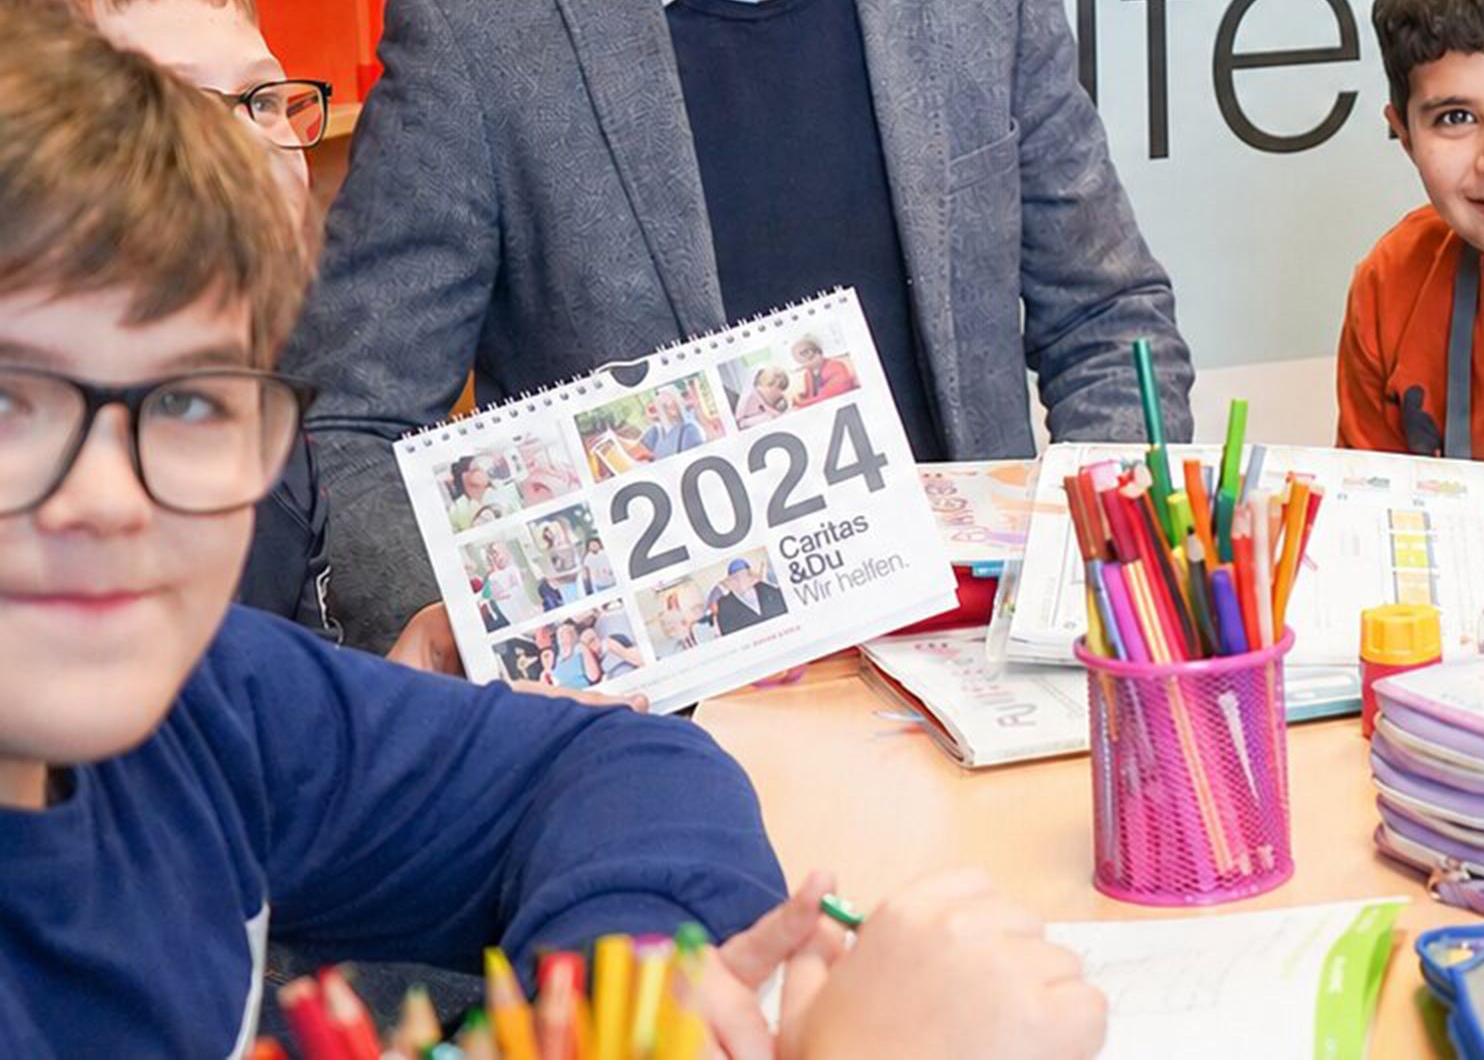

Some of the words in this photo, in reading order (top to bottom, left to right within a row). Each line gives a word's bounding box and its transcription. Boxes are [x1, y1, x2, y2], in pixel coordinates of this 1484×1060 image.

[610, 402, 888, 580] 2024
[779, 515, 869, 560] Caritas
[788, 549, 844, 585] &Du
[793, 579, 832, 607] Wir
